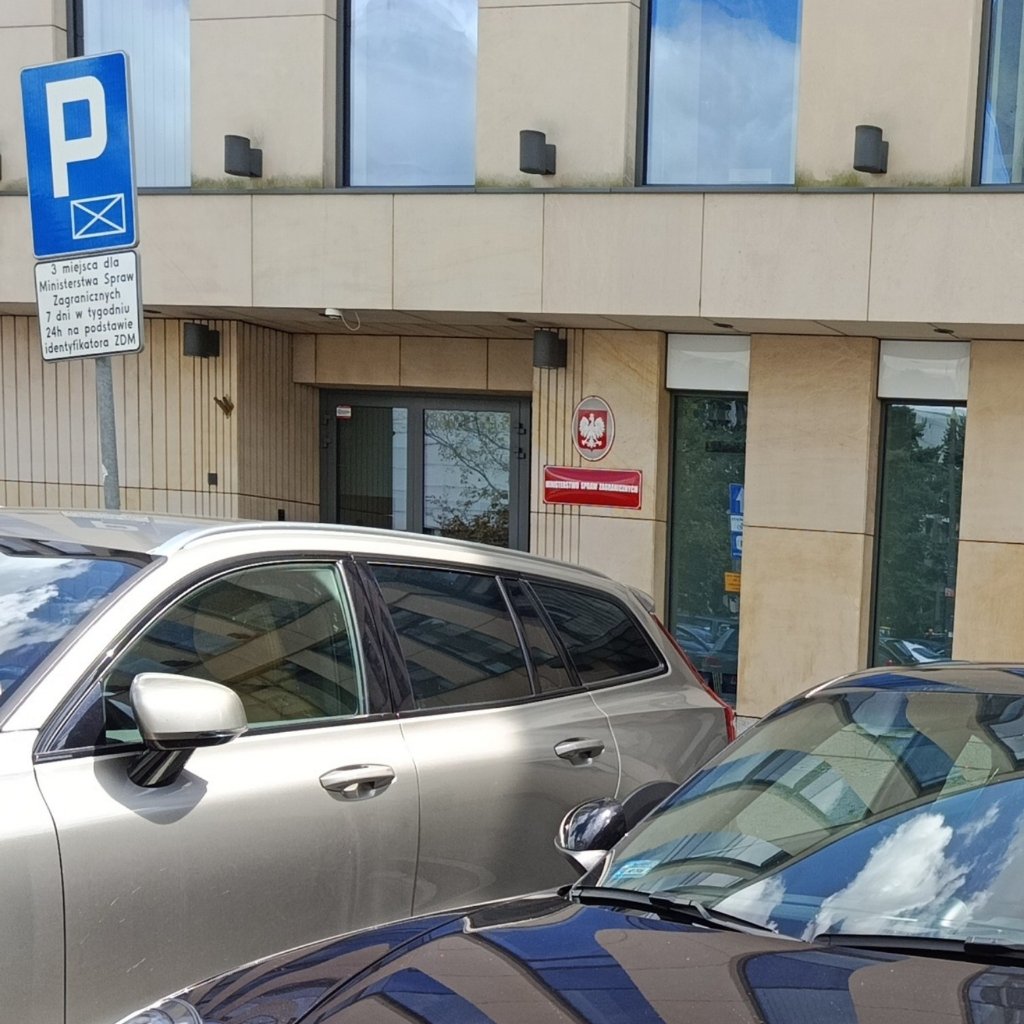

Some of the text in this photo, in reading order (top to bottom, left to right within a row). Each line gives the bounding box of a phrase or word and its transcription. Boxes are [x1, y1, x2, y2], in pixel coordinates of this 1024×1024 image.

[46, 75, 108, 198] P
[51, 257, 119, 275] 3 miejsca dla
[40, 273, 134, 292] Ministerstwa Spraw
[53, 288, 120, 308] Zagranicznych
[46, 303, 130, 322] 7 dni w tygodniu
[46, 318, 133, 338] 24h na podstawie
[45, 333, 136, 356] identyfikatora ZDM
